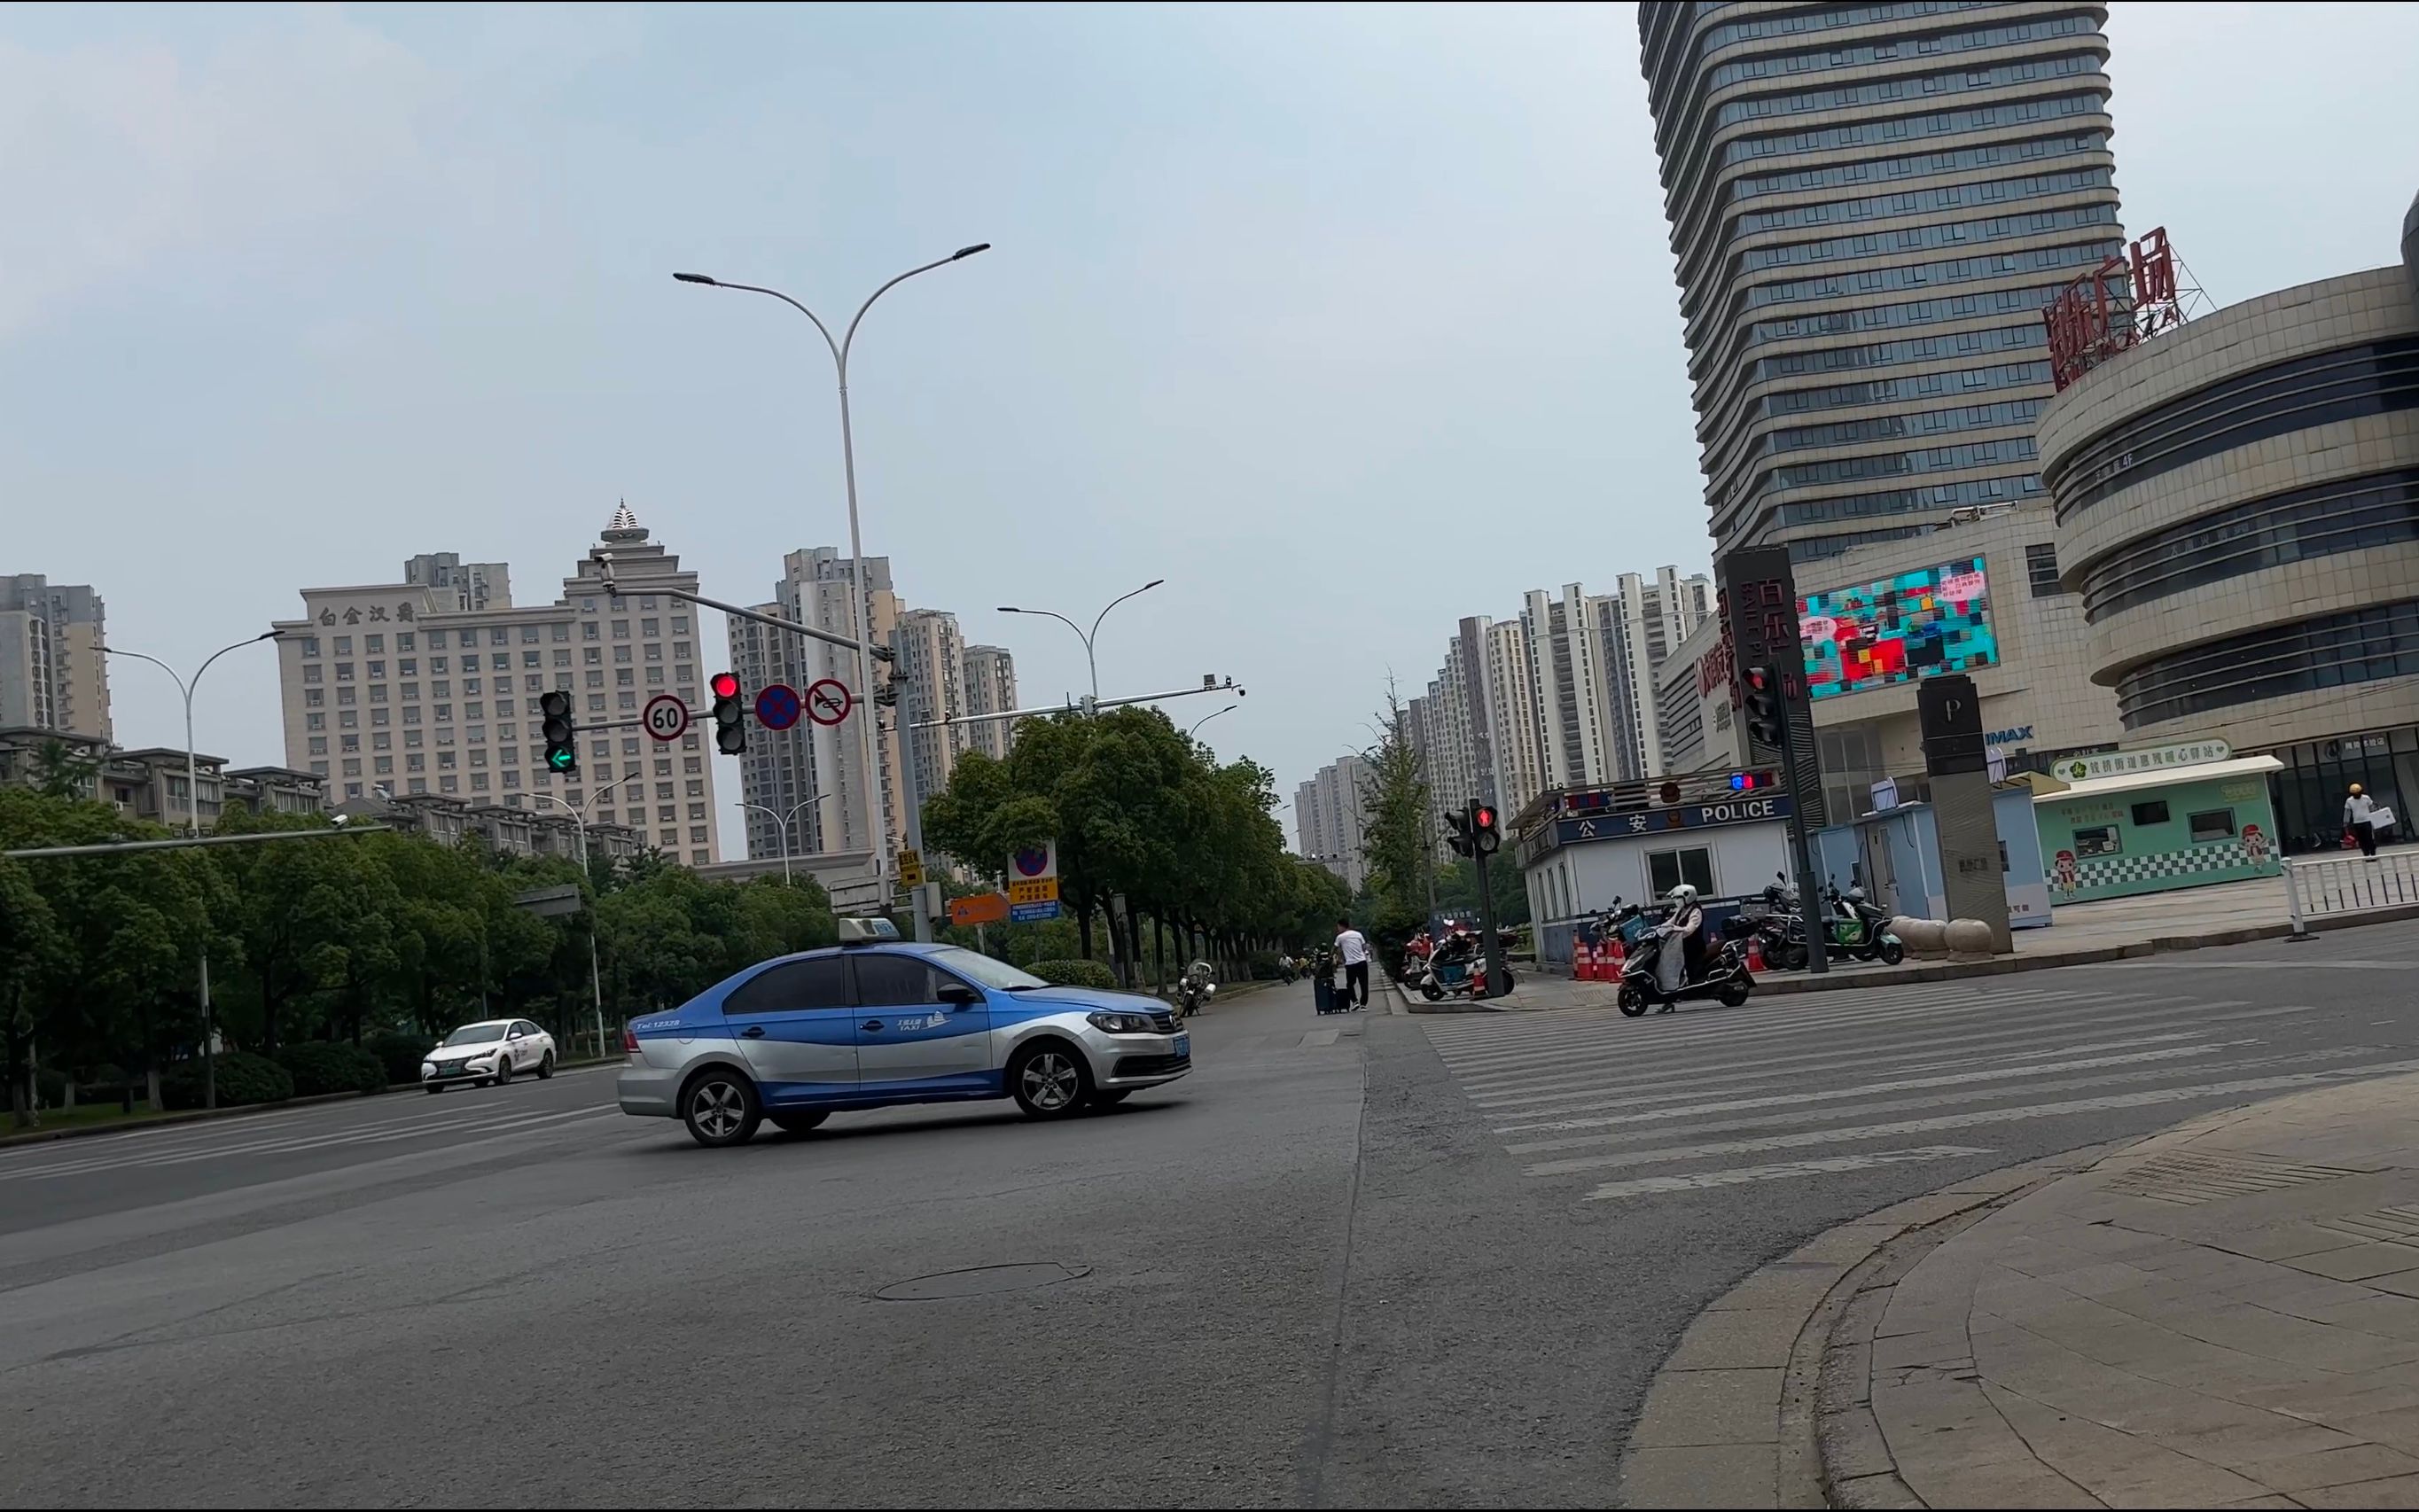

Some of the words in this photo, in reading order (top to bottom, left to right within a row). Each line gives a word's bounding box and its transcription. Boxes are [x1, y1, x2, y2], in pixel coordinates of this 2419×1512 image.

[652, 707, 678, 729] 60
[1945, 698, 1962, 722] P
[1985, 725, 2033, 747] IMAX
[1701, 799, 1775, 823] POLICE
[1578, 814, 1648, 838] 公安
